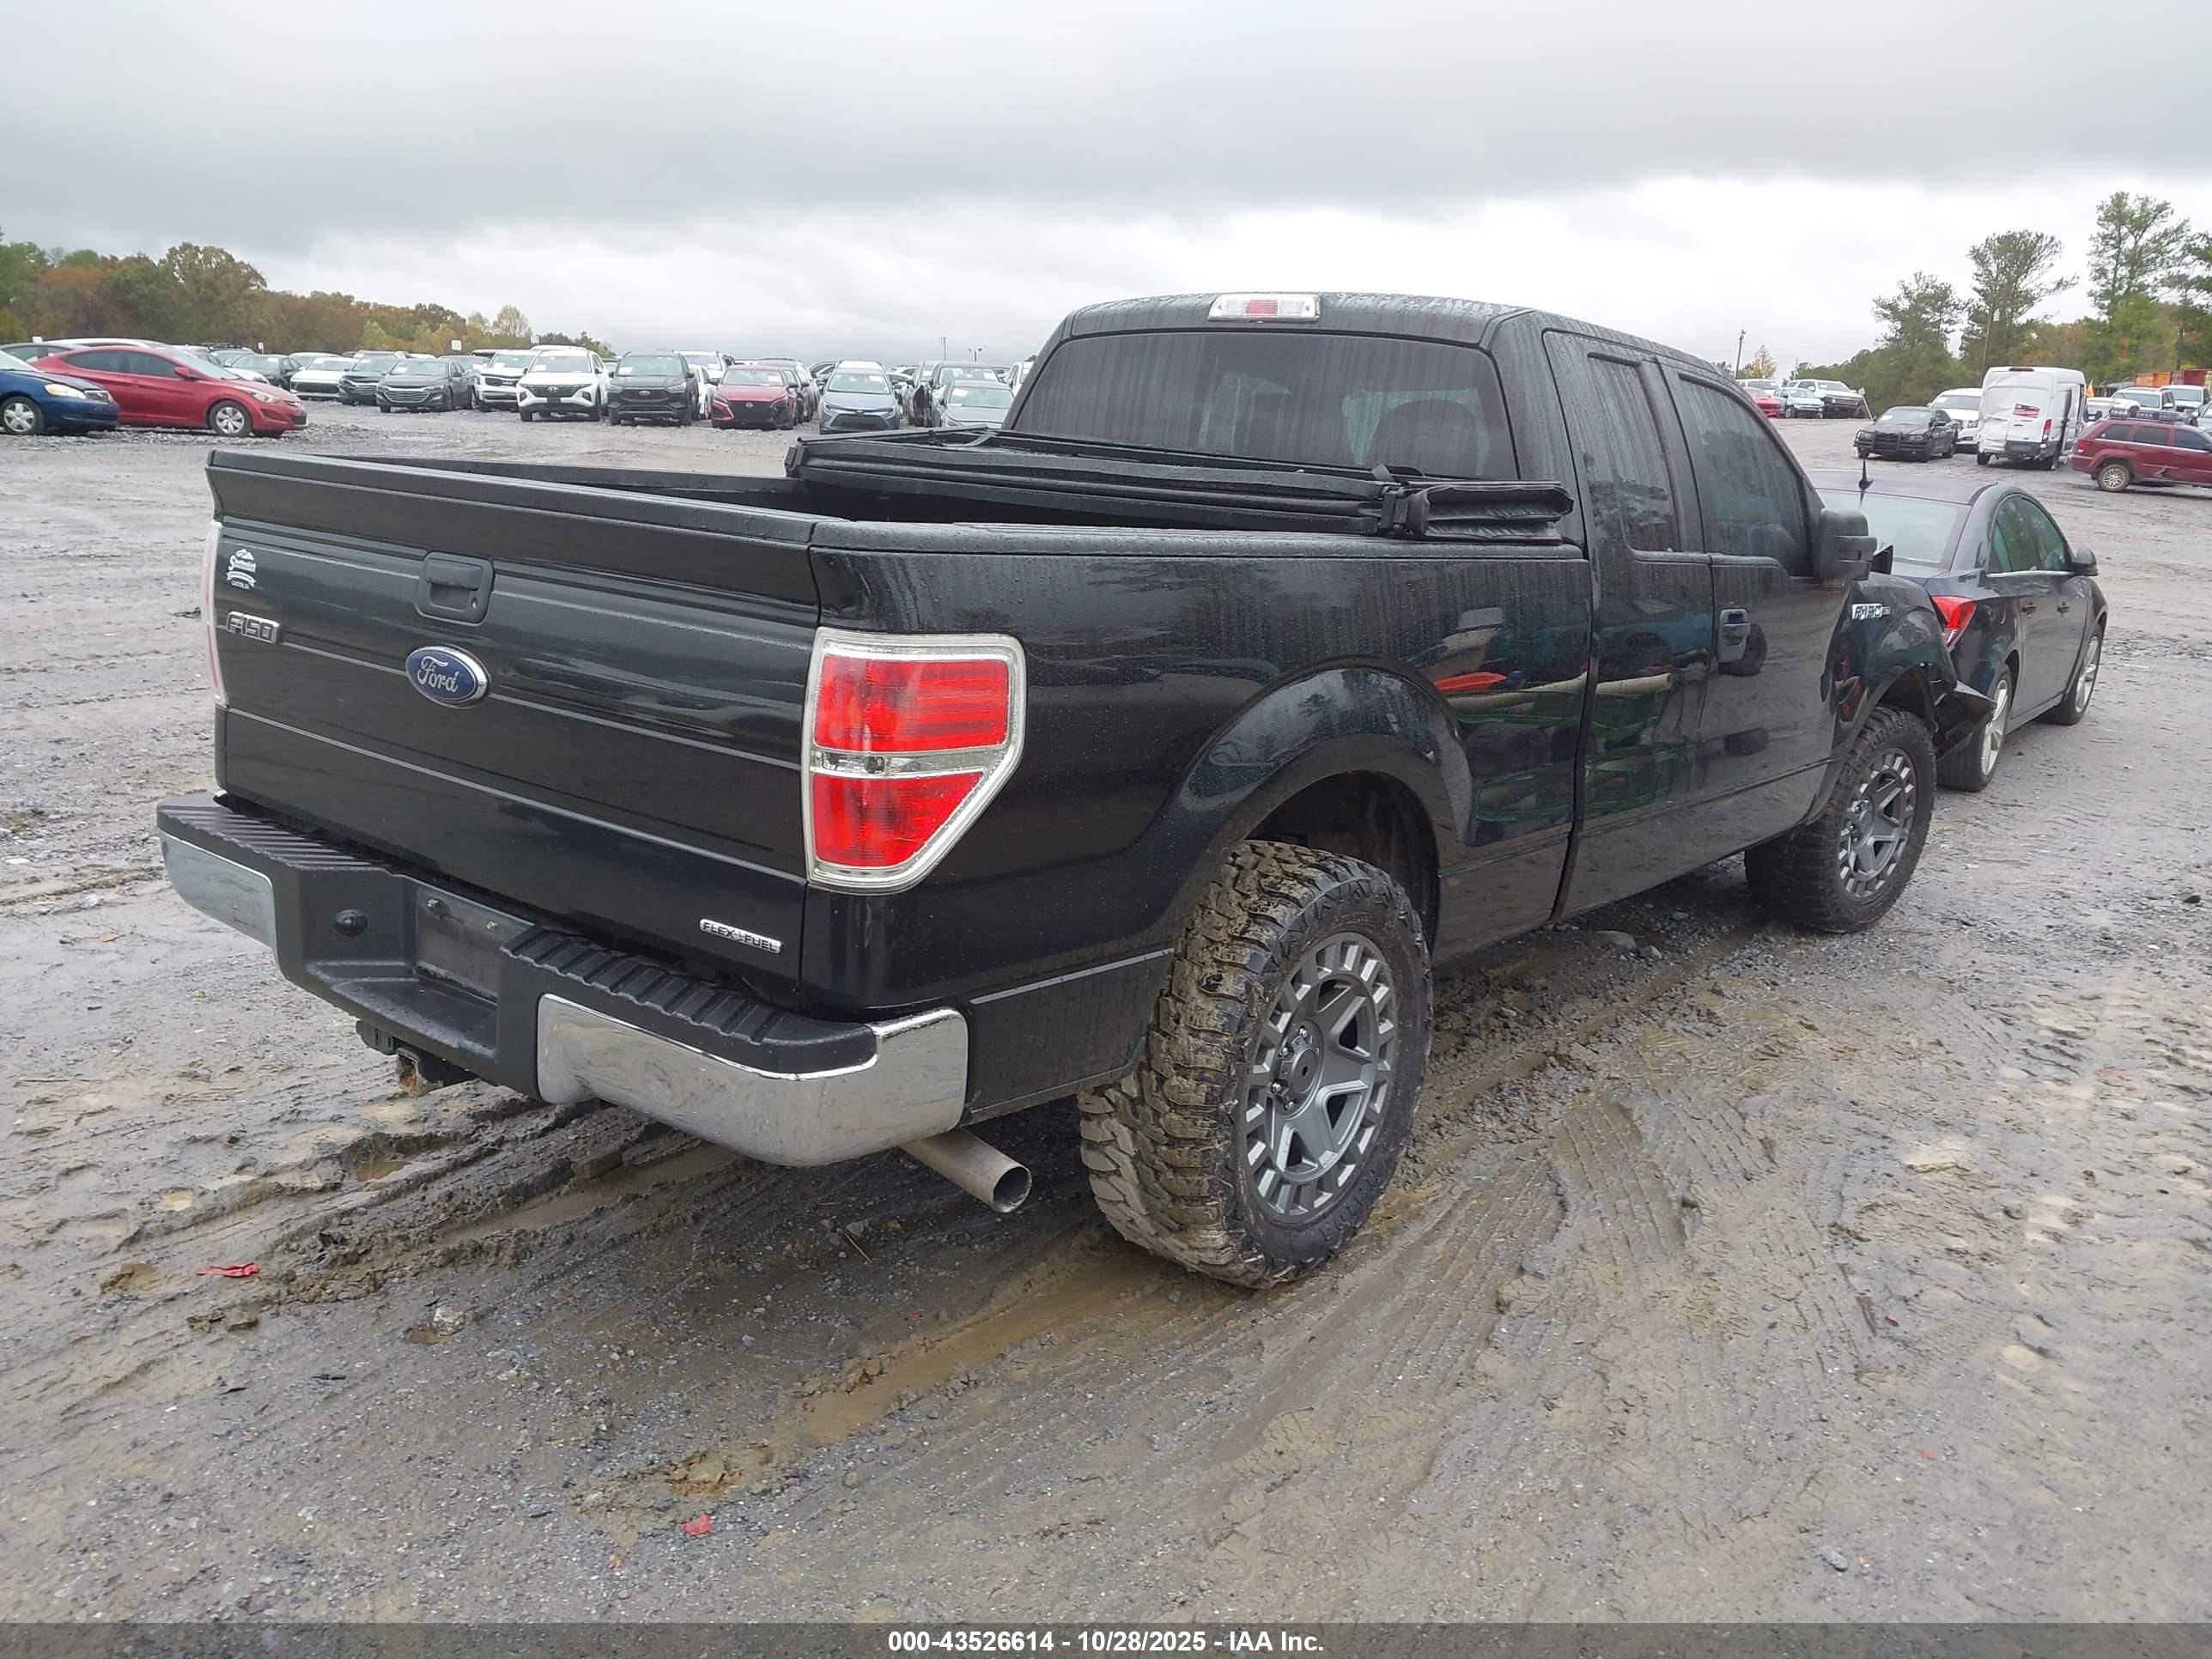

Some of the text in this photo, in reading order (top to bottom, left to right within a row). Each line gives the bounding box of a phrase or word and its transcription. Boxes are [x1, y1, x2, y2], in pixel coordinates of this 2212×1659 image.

[418, 656, 459, 694] Ford
[702, 921, 780, 952] FLEX FUEL
